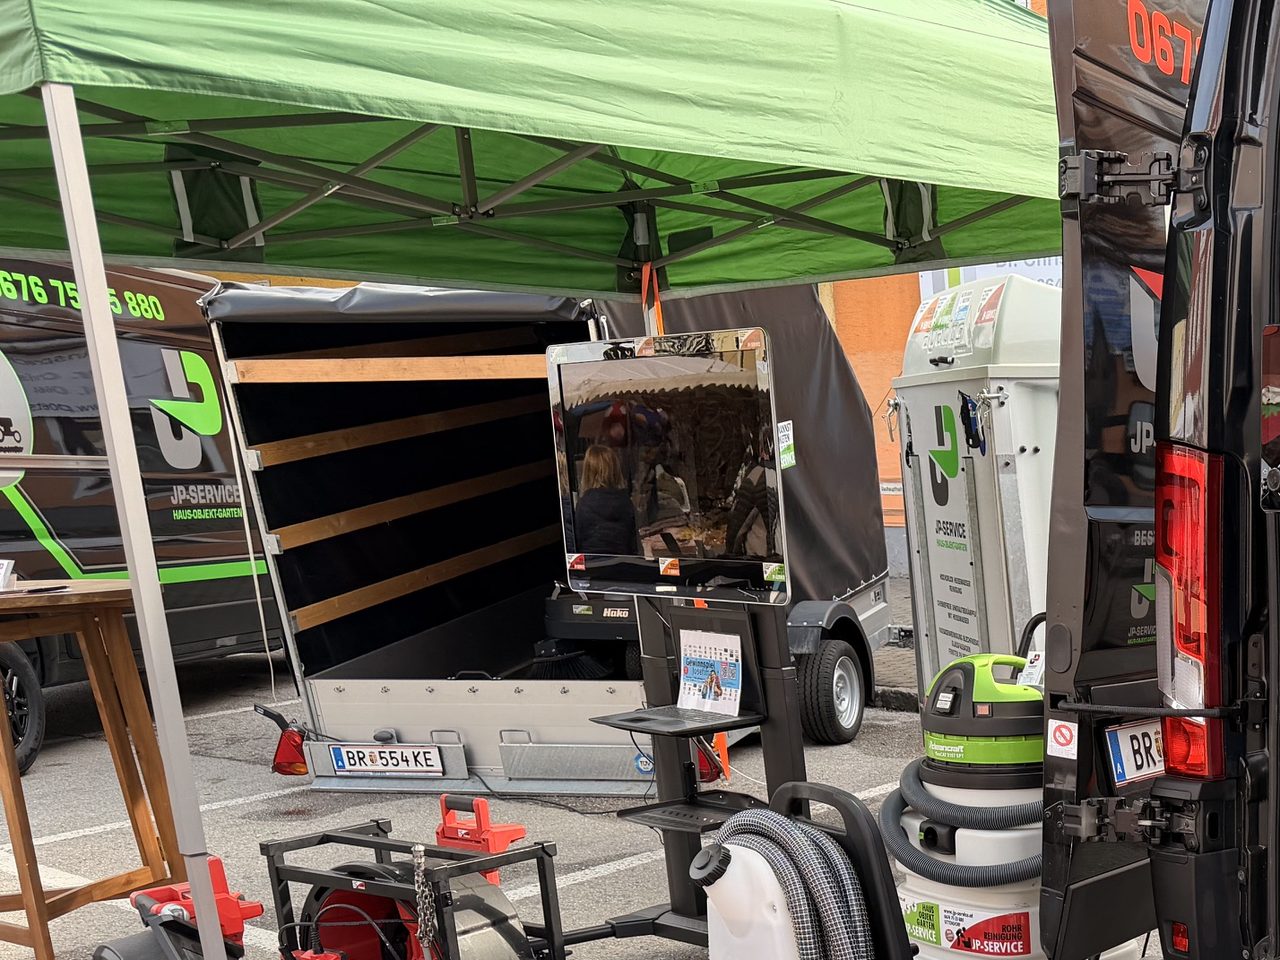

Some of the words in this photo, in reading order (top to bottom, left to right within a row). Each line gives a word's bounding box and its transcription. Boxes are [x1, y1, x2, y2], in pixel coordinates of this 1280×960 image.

[1128, 0, 1202, 85] 067
[0, 270, 48, 304] 676
[124, 291, 165, 321] 880
[171, 485, 240, 504] JP-SERVICE
[602, 608, 630, 618] Hako
[346, 750, 368, 767] BR
[378, 750, 410, 767] 554
[412, 751, 434, 768] KE
[1117, 763, 1123, 774] A
[1129, 731, 1157, 771] BR
[918, 911, 935, 921] OBJEKT
[921, 904, 934, 914] HAUS
[916, 918, 935, 930] GARTEN
[1001, 924, 1022, 933] ROHR
[906, 923, 937, 942] P-SERVICE
[984, 932, 1022, 941] REINIGUNG
[971, 939, 1024, 953] JP-SERVICE
